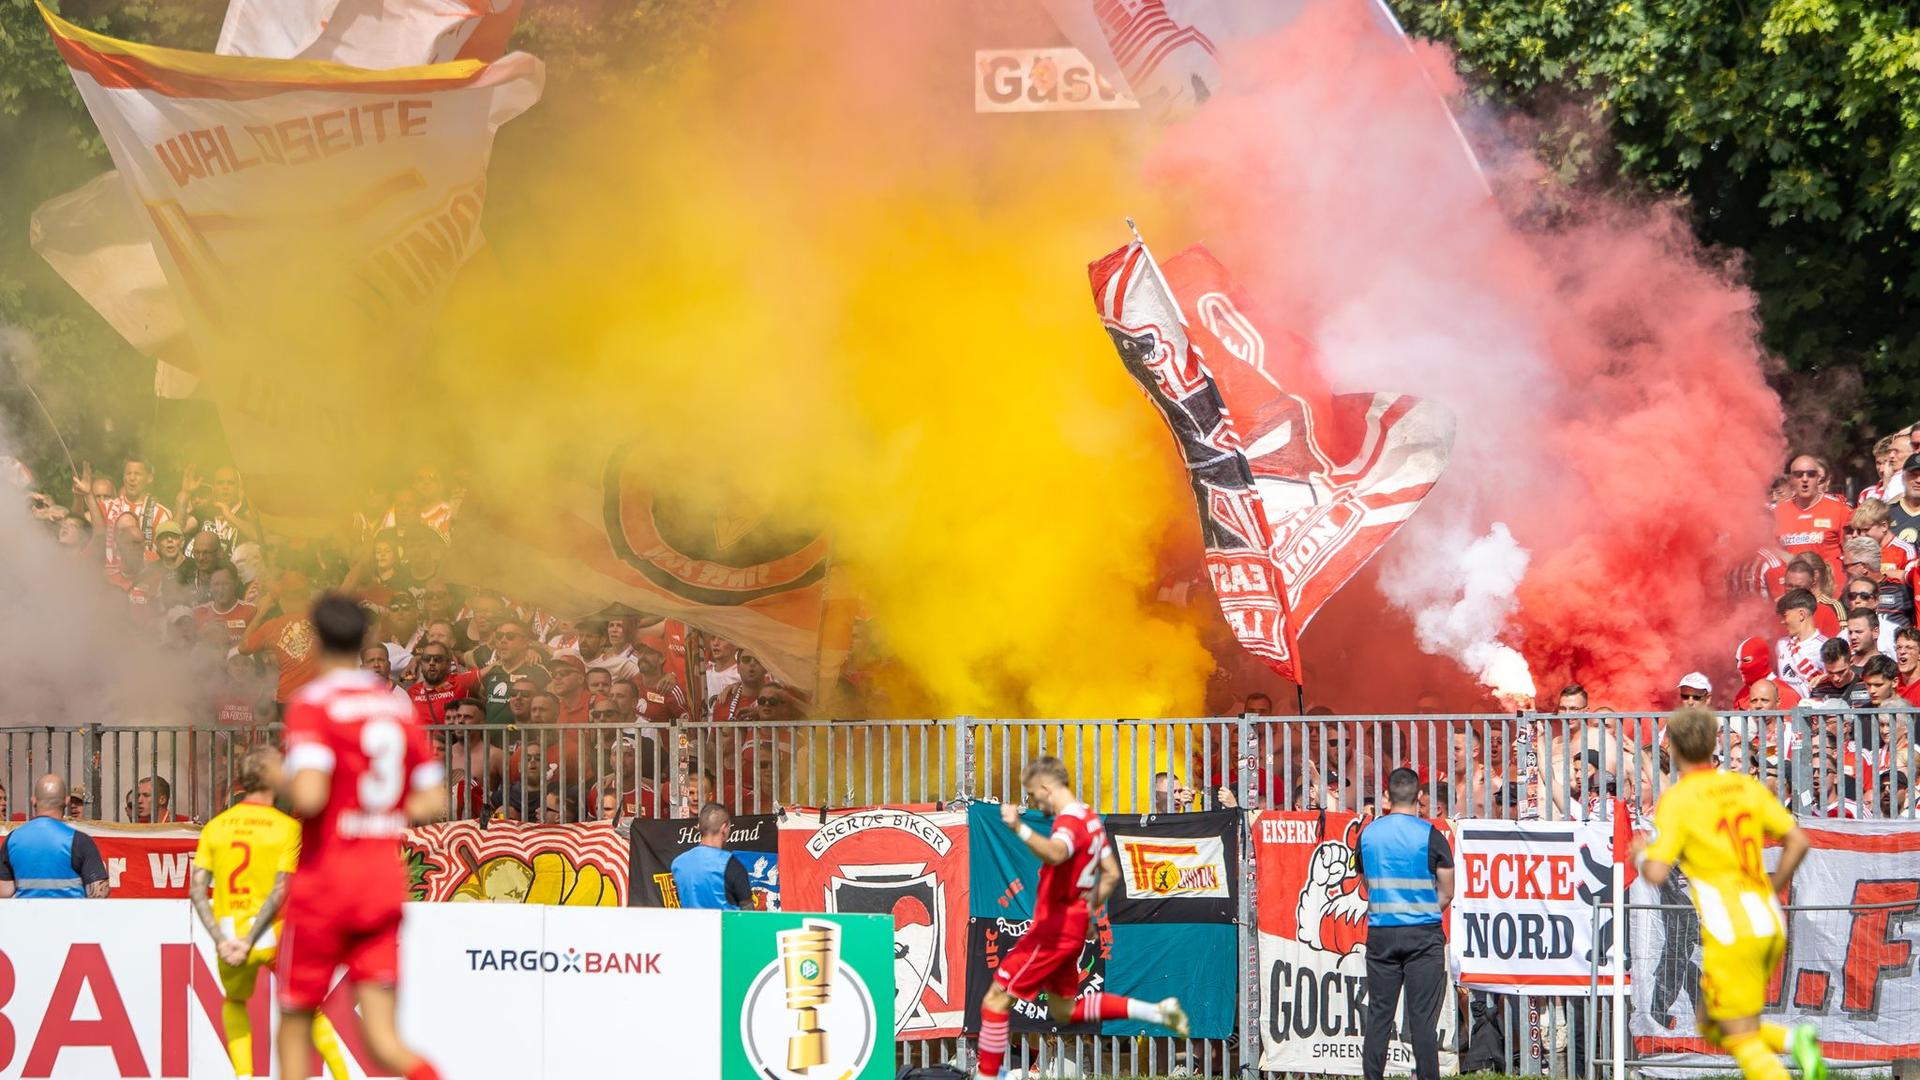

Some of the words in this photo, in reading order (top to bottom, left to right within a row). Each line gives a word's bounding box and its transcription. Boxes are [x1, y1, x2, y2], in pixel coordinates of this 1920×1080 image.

[154, 100, 432, 188] WALDSEITE
[357, 719, 408, 813] 3
[813, 813, 885, 852] EISERNE
[893, 814, 945, 850] BIKER
[1261, 820, 1318, 843] EISERN
[1716, 811, 1767, 888] 16
[228, 841, 251, 894] 2
[1463, 853, 1575, 901] ECKE
[986, 928, 1000, 968] UFC
[1463, 912, 1575, 960] NORD
